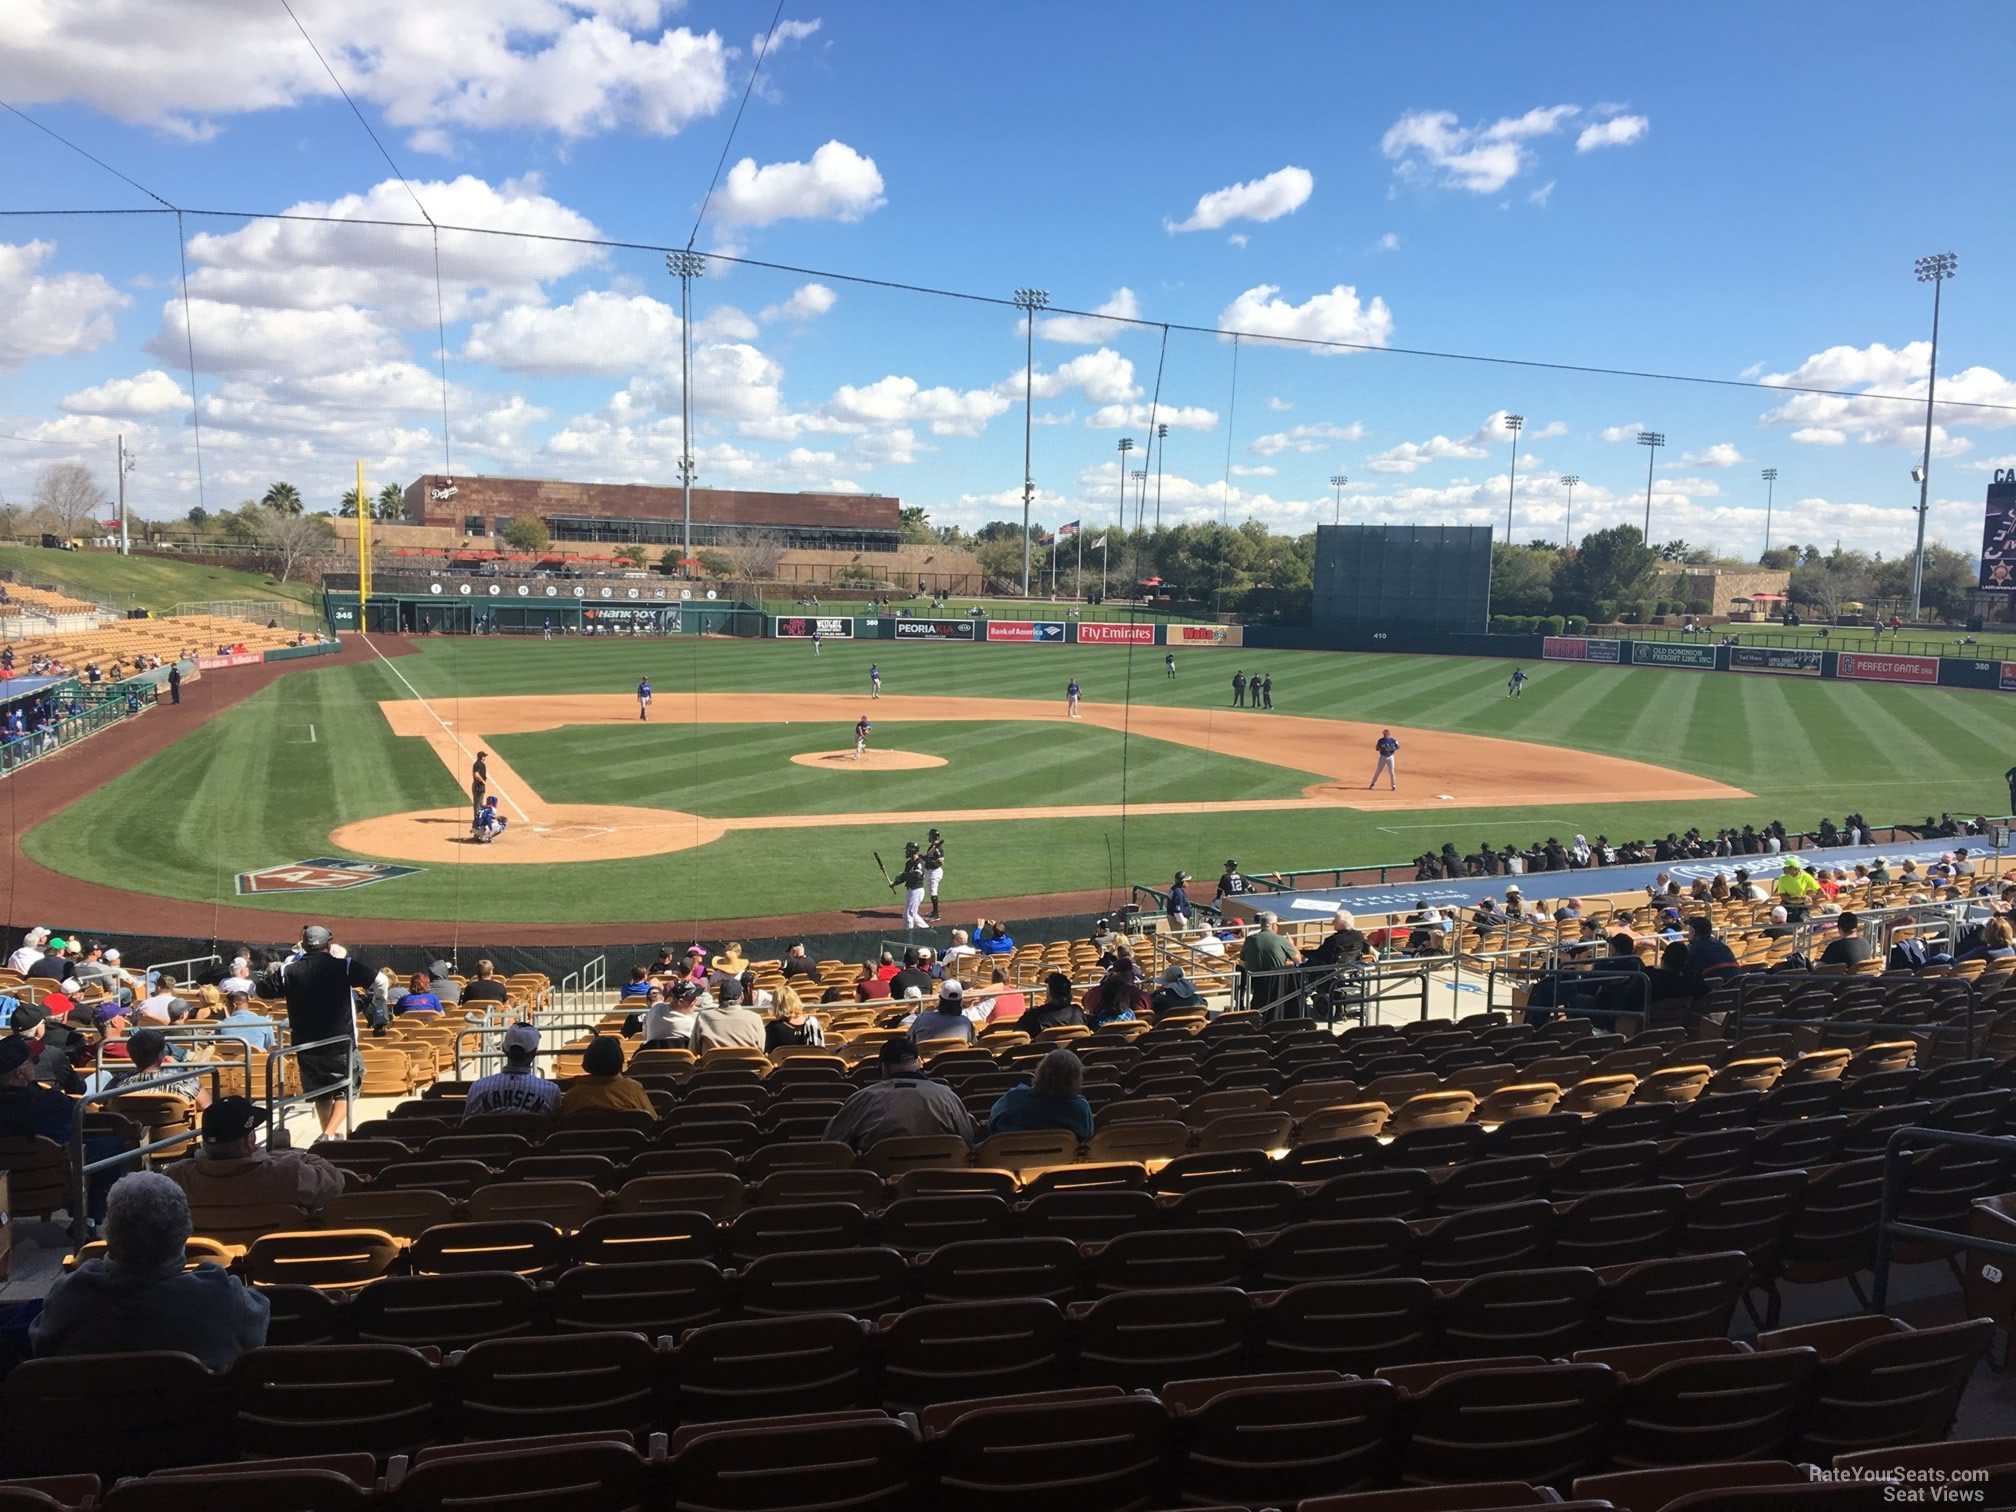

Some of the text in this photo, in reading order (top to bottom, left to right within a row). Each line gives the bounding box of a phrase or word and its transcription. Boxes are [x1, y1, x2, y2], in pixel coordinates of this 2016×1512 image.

[432, 486, 458, 499] Dodgers
[898, 624, 936, 633] PEORIA
[1082, 626, 1151, 640] Fly Emirates
[1857, 662, 1893, 672] PERFECT
[258, 870, 360, 886] AZ
[1230, 880, 1242, 892] 12
[1987, 1268, 1998, 1280] 12
